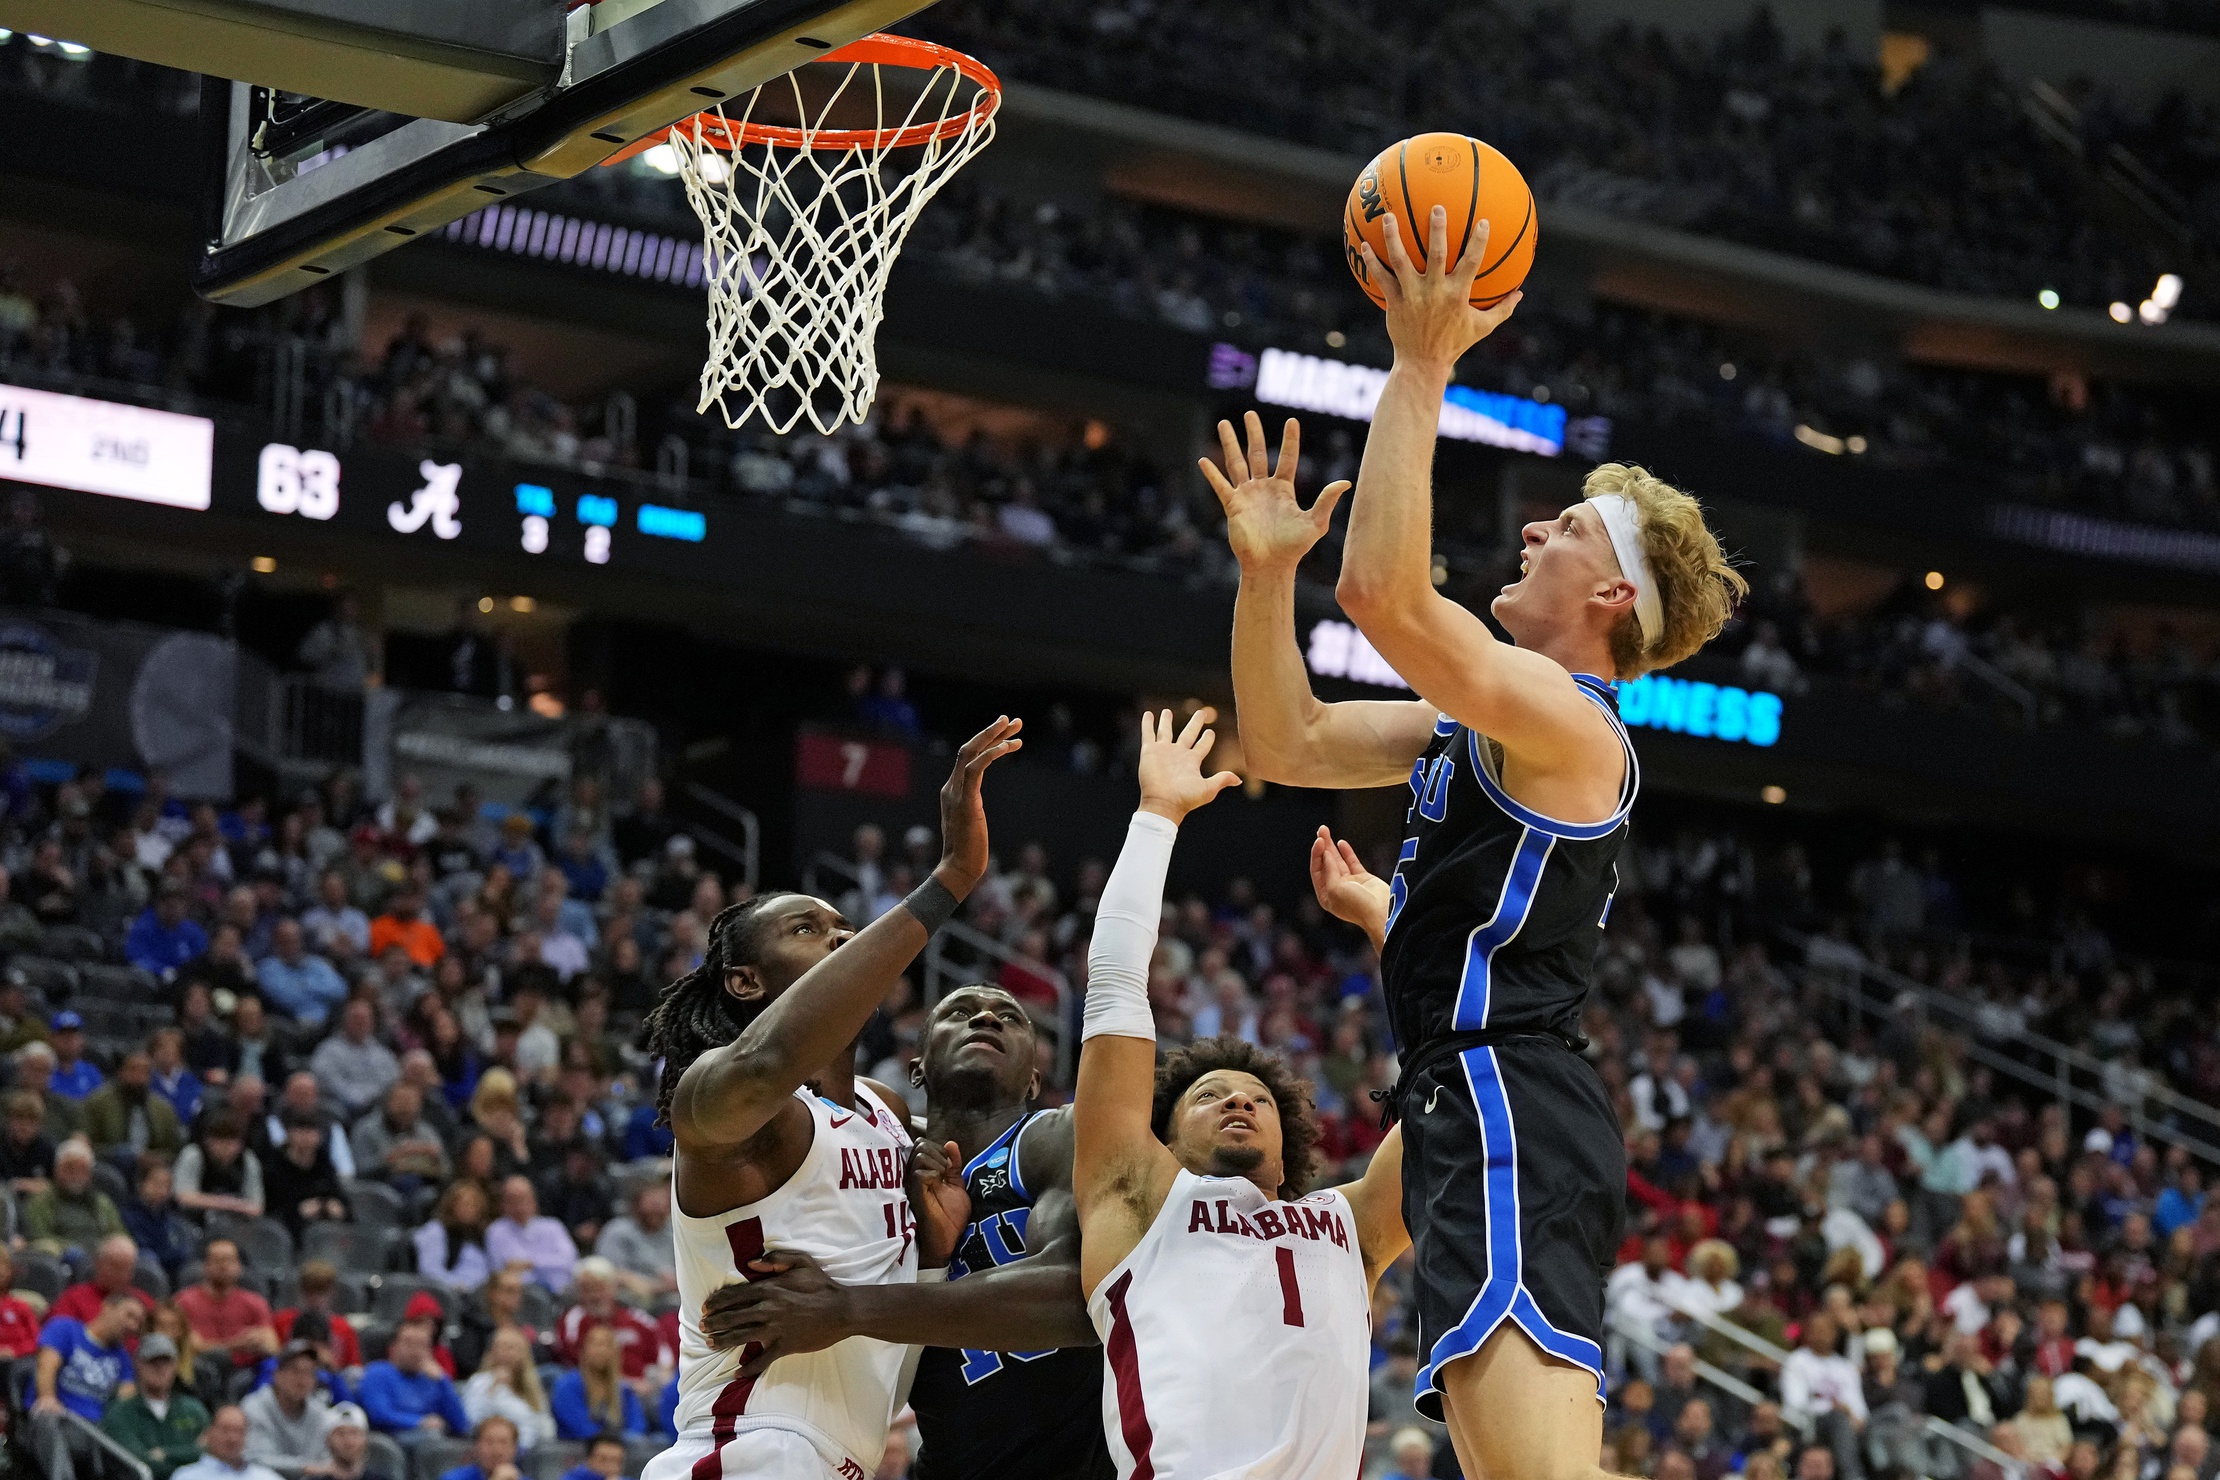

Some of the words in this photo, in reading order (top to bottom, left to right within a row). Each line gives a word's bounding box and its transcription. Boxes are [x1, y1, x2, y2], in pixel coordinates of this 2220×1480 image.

[258, 443, 340, 521] 63
[839, 1147, 906, 1190] ALABA
[1188, 1199, 1350, 1254] ALABAMA
[1275, 1245, 1305, 1328] 1
